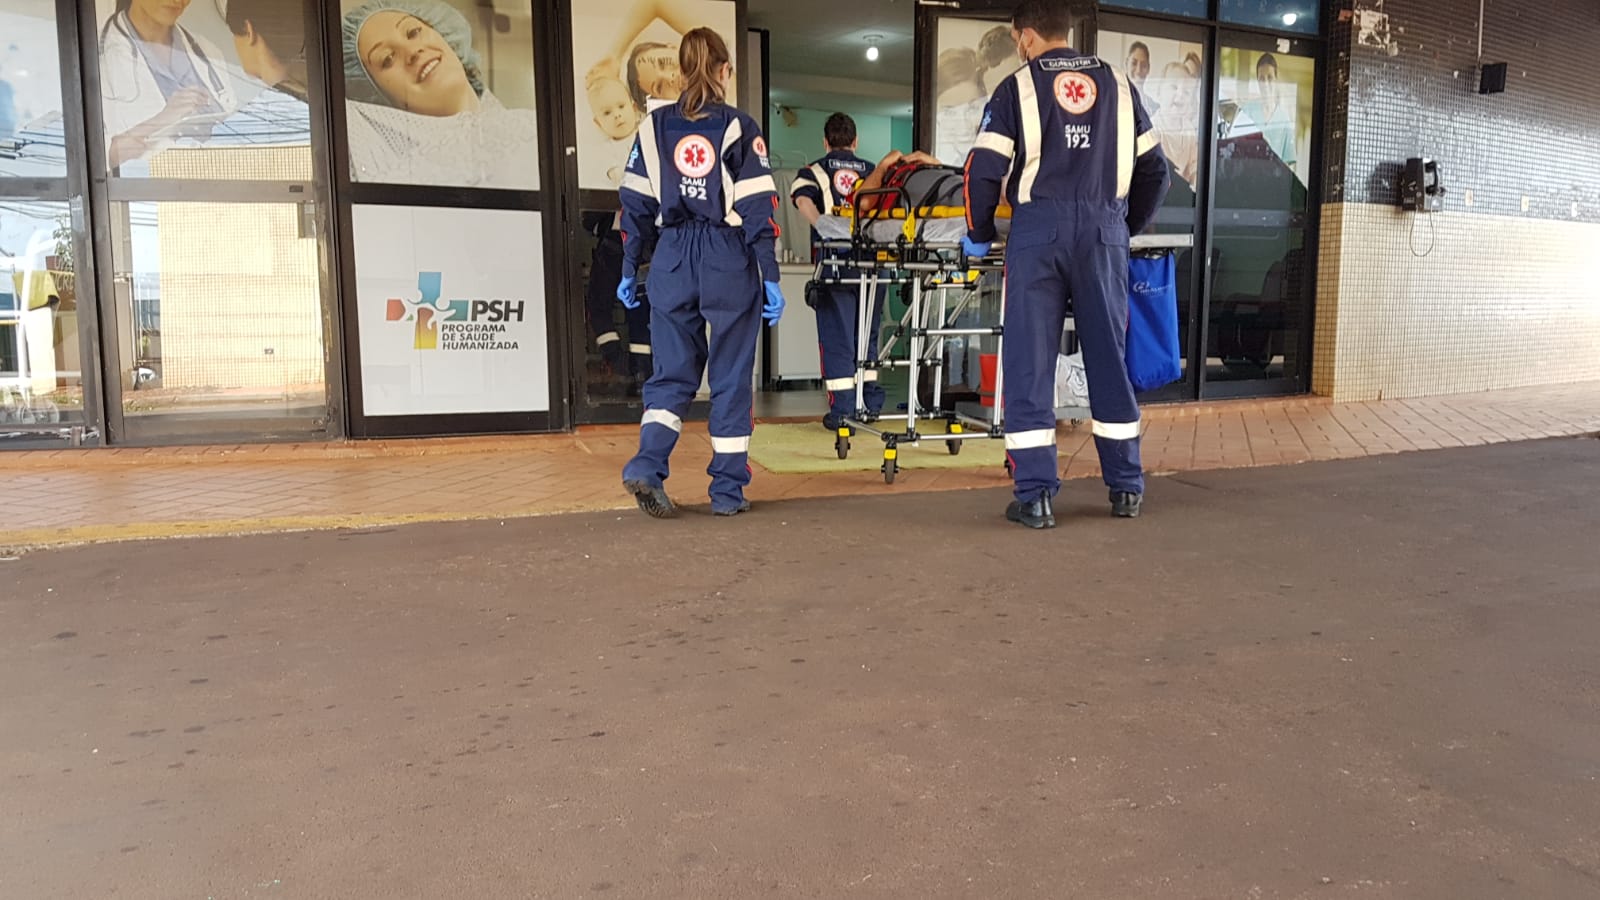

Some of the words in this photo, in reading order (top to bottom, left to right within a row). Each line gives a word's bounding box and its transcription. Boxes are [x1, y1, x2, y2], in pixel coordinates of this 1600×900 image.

[1064, 124, 1091, 134] SAMU
[1065, 133, 1091, 149] 192
[681, 176, 706, 187] SAMU
[679, 183, 707, 201] 192
[471, 300, 525, 322] PSH
[441, 324, 506, 333] PROGRAMA
[442, 333, 456, 341] DE
[442, 341, 519, 350] HUMANIZADA
